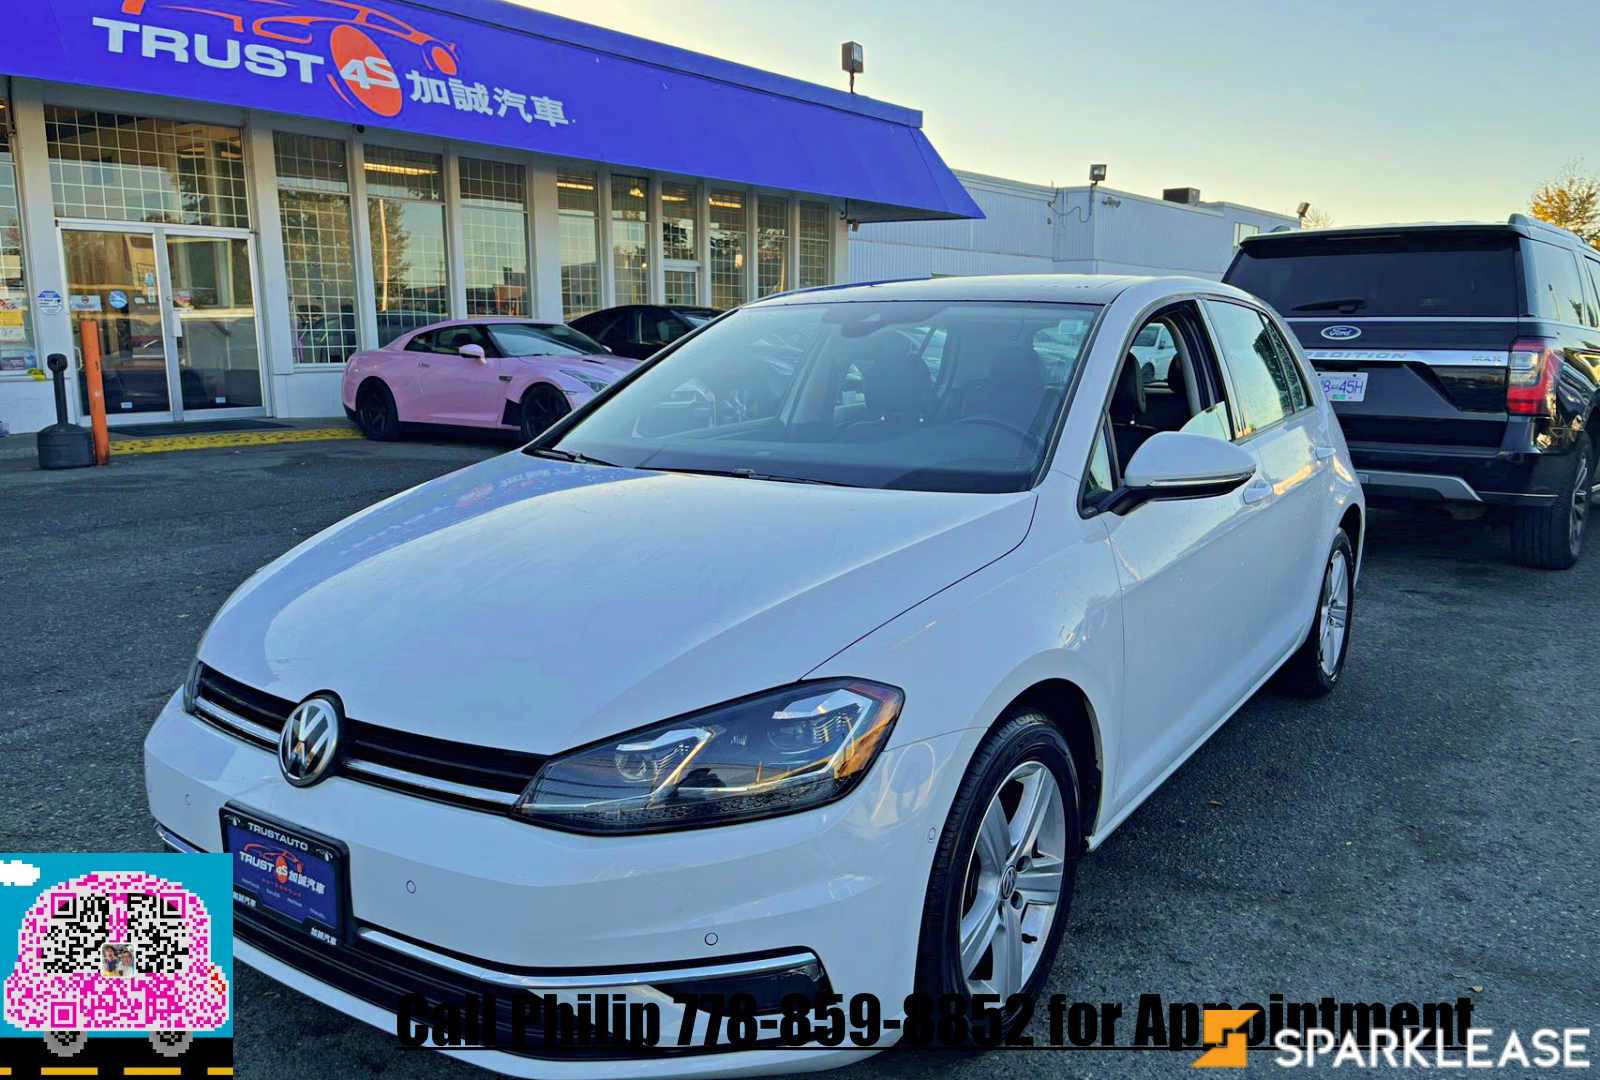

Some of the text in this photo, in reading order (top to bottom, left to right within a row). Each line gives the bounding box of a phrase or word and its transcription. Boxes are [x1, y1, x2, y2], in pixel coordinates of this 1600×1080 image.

[92, 16, 401, 91] TRUST 4S
[405, 70, 571, 129] 加誠汽車
[248, 822, 309, 851] TRUSTAUTO
[239, 851, 275, 873] TRUST
